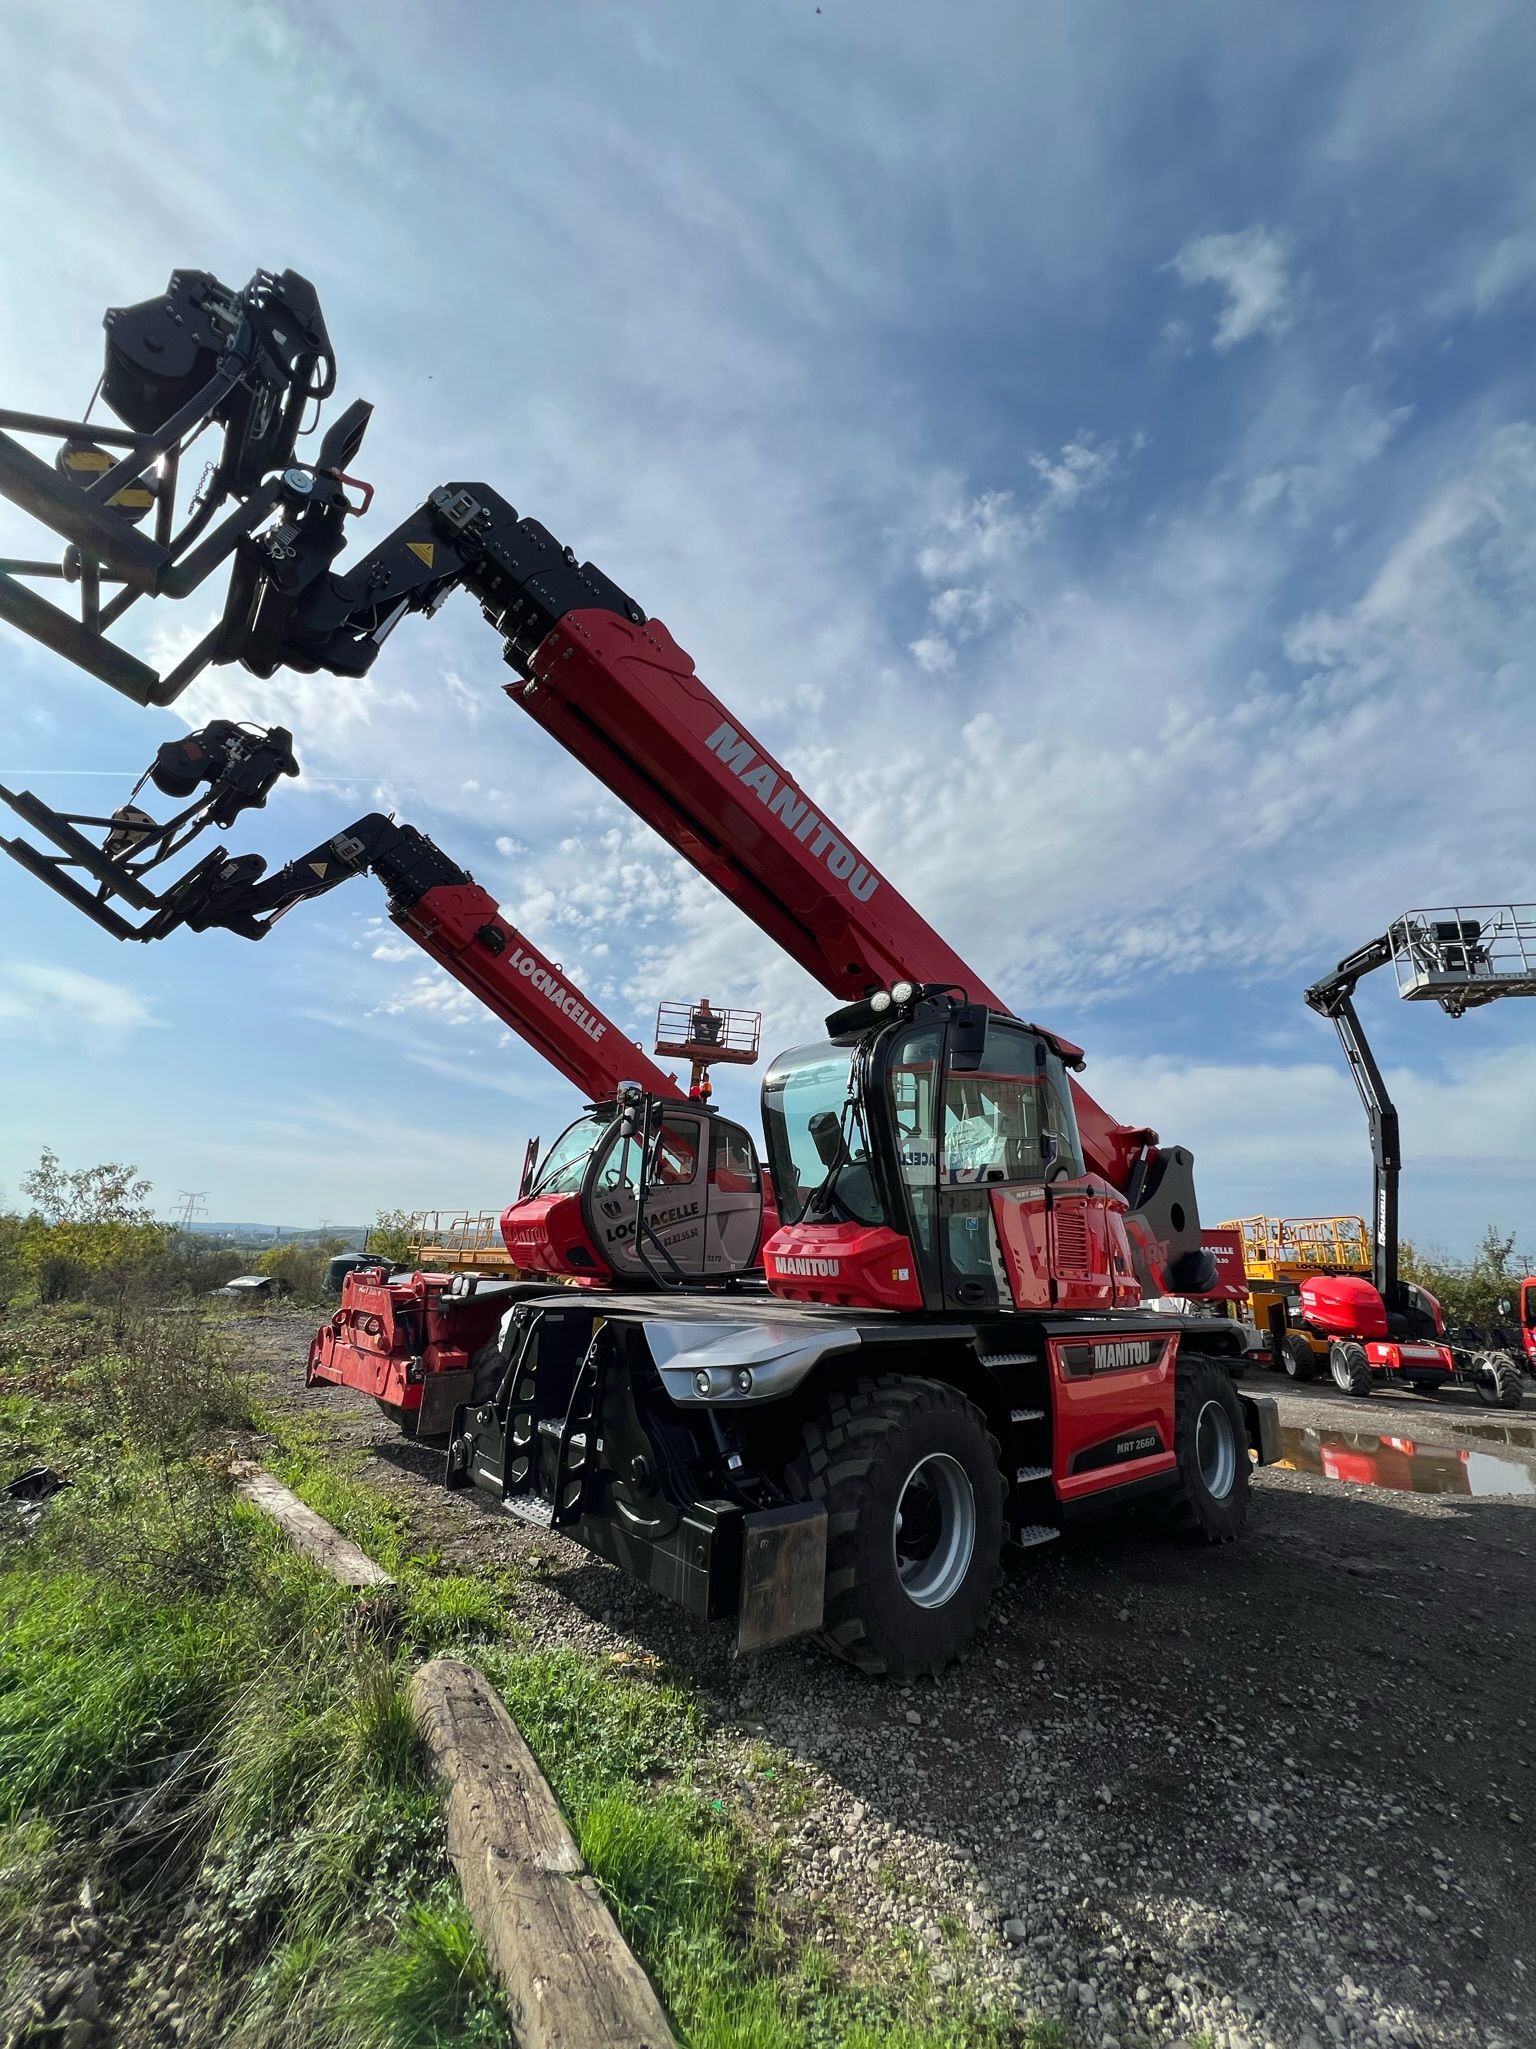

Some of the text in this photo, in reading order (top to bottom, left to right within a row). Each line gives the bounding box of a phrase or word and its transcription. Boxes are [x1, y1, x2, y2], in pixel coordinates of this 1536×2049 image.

[704, 721, 880, 902] MANITOU
[508, 948, 607, 1042] LOCNACELLE
[774, 1256, 840, 1277] MANITOU
[1094, 1341, 1150, 1369] MANITOU
[1116, 1436, 1156, 1454] MRT 2660
